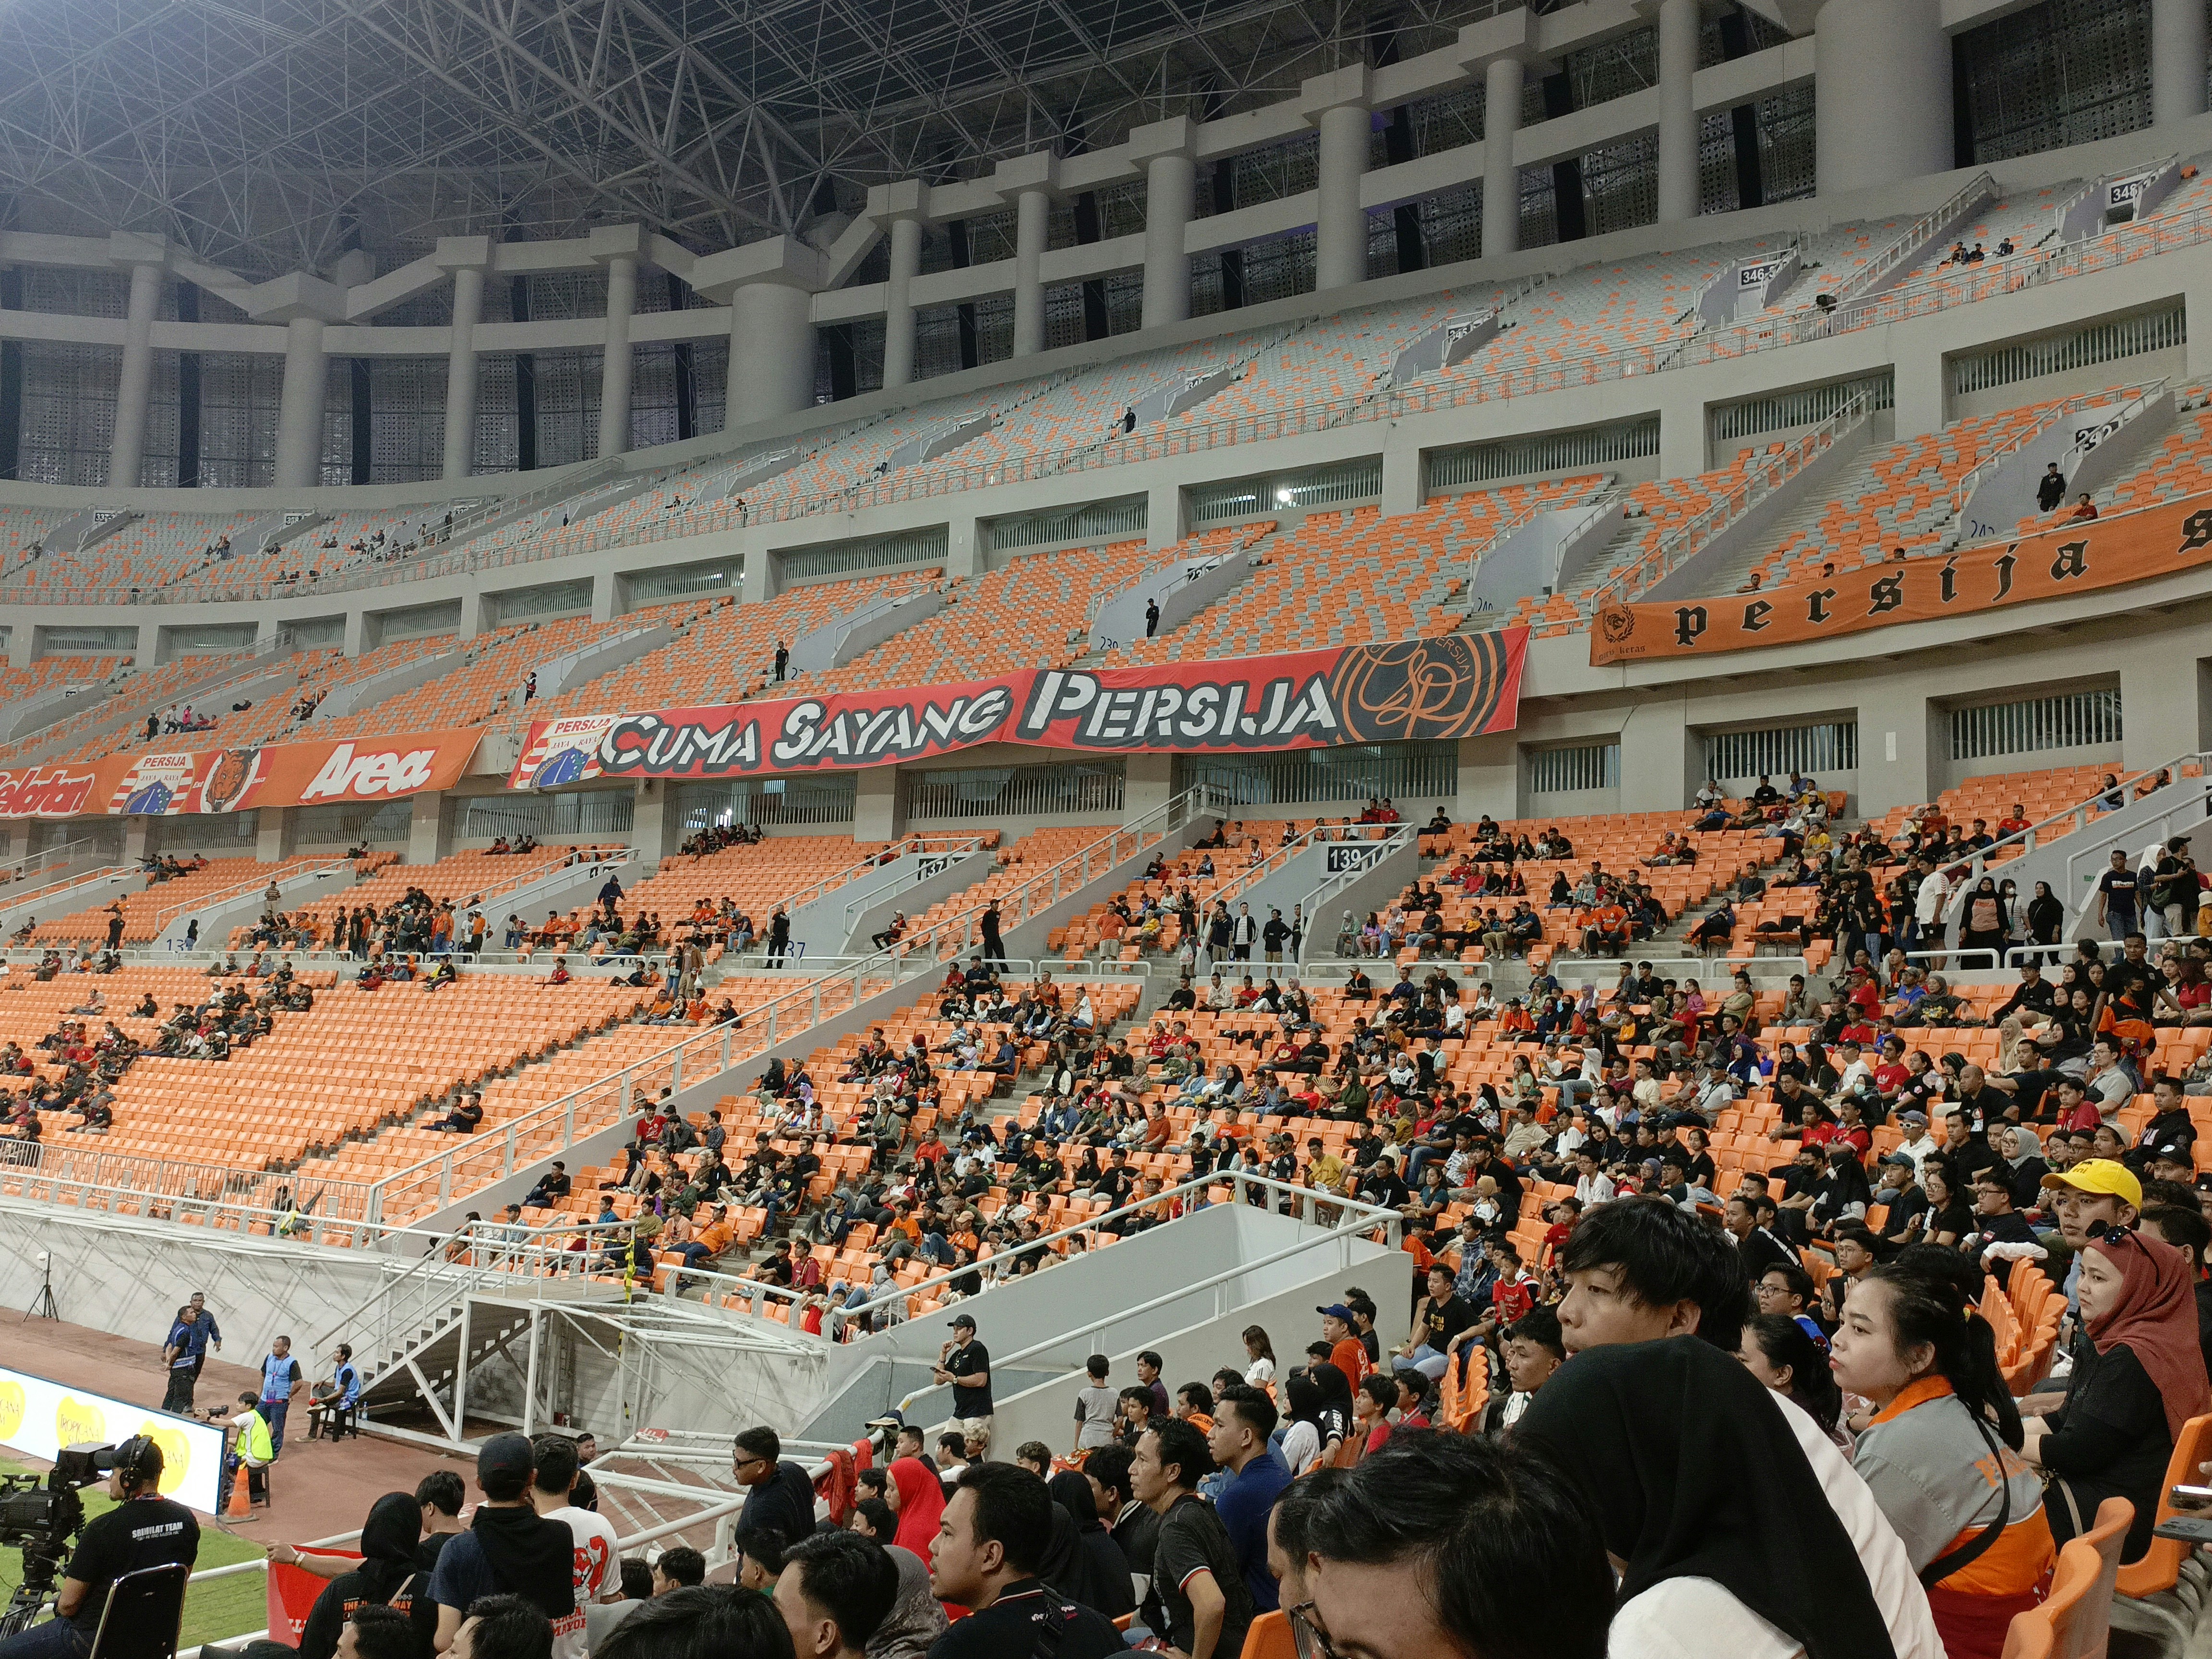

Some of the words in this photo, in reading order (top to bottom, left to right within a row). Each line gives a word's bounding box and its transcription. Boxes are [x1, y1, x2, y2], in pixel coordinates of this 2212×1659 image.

[554, 718, 612, 734] PERSIJA
[598, 715, 757, 766] CUMA
[774, 689, 1006, 760] SAYANG
[1026, 671, 1338, 738] PERSIJA
[551, 740, 570, 750] JAYA
[143, 756, 186, 768] PERSIJA
[299, 742, 437, 801] Area
[60, 1414, 100, 1443] TROPICANA
[165, 1522, 183, 1532] TEAM
